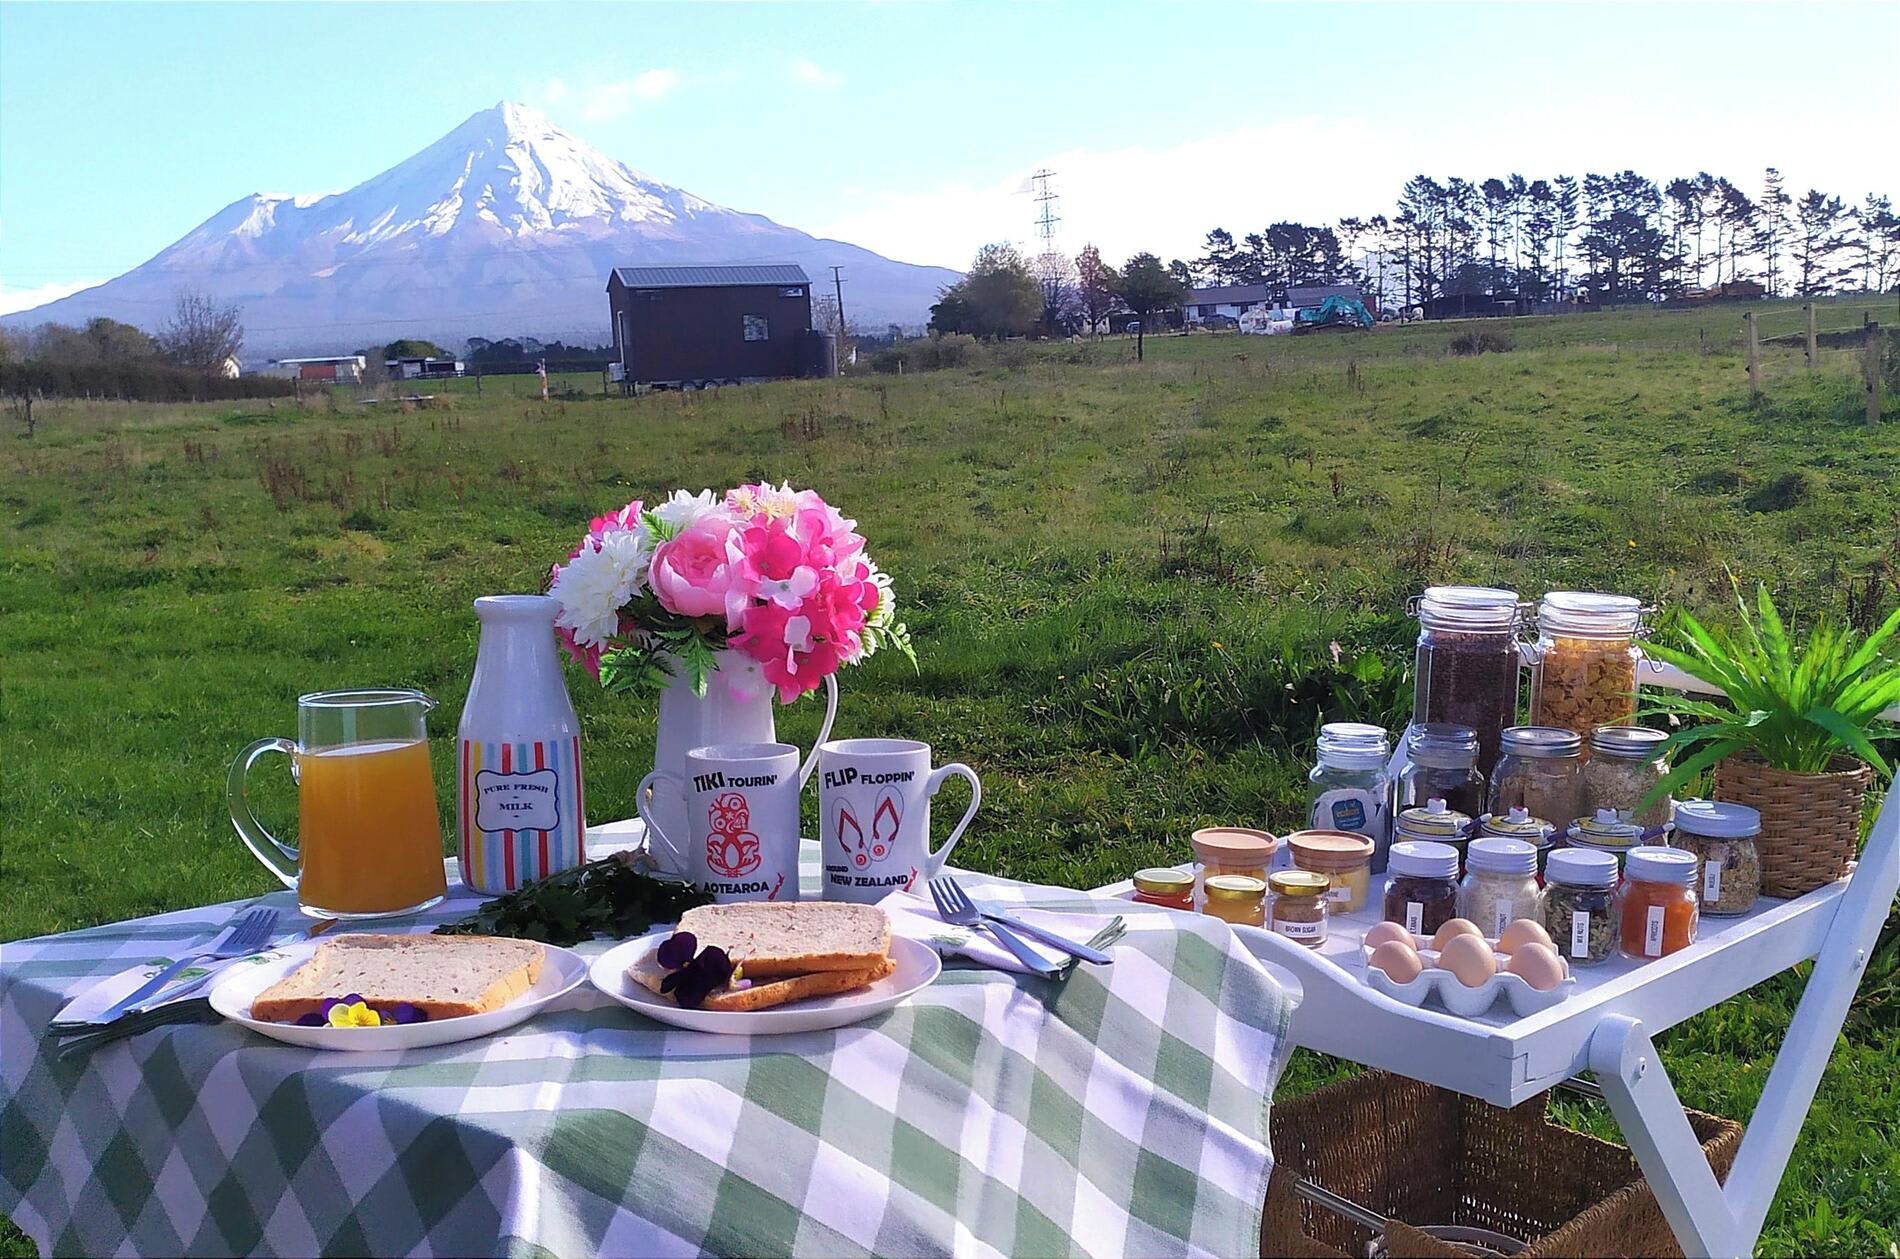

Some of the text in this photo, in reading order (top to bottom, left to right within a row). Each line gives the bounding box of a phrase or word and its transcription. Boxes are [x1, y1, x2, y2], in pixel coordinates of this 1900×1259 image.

[693, 772, 778, 792] TIKI TOURIN'
[825, 767, 915, 789] FLIP FLOPPIN'
[484, 783, 549, 795] PURE FRESH
[499, 803, 533, 811] MILK
[831, 874, 909, 887] NEW ZEALAND
[704, 881, 770, 894] AOTEAROA
[1285, 925, 1316, 934] BROWN SUGAR
